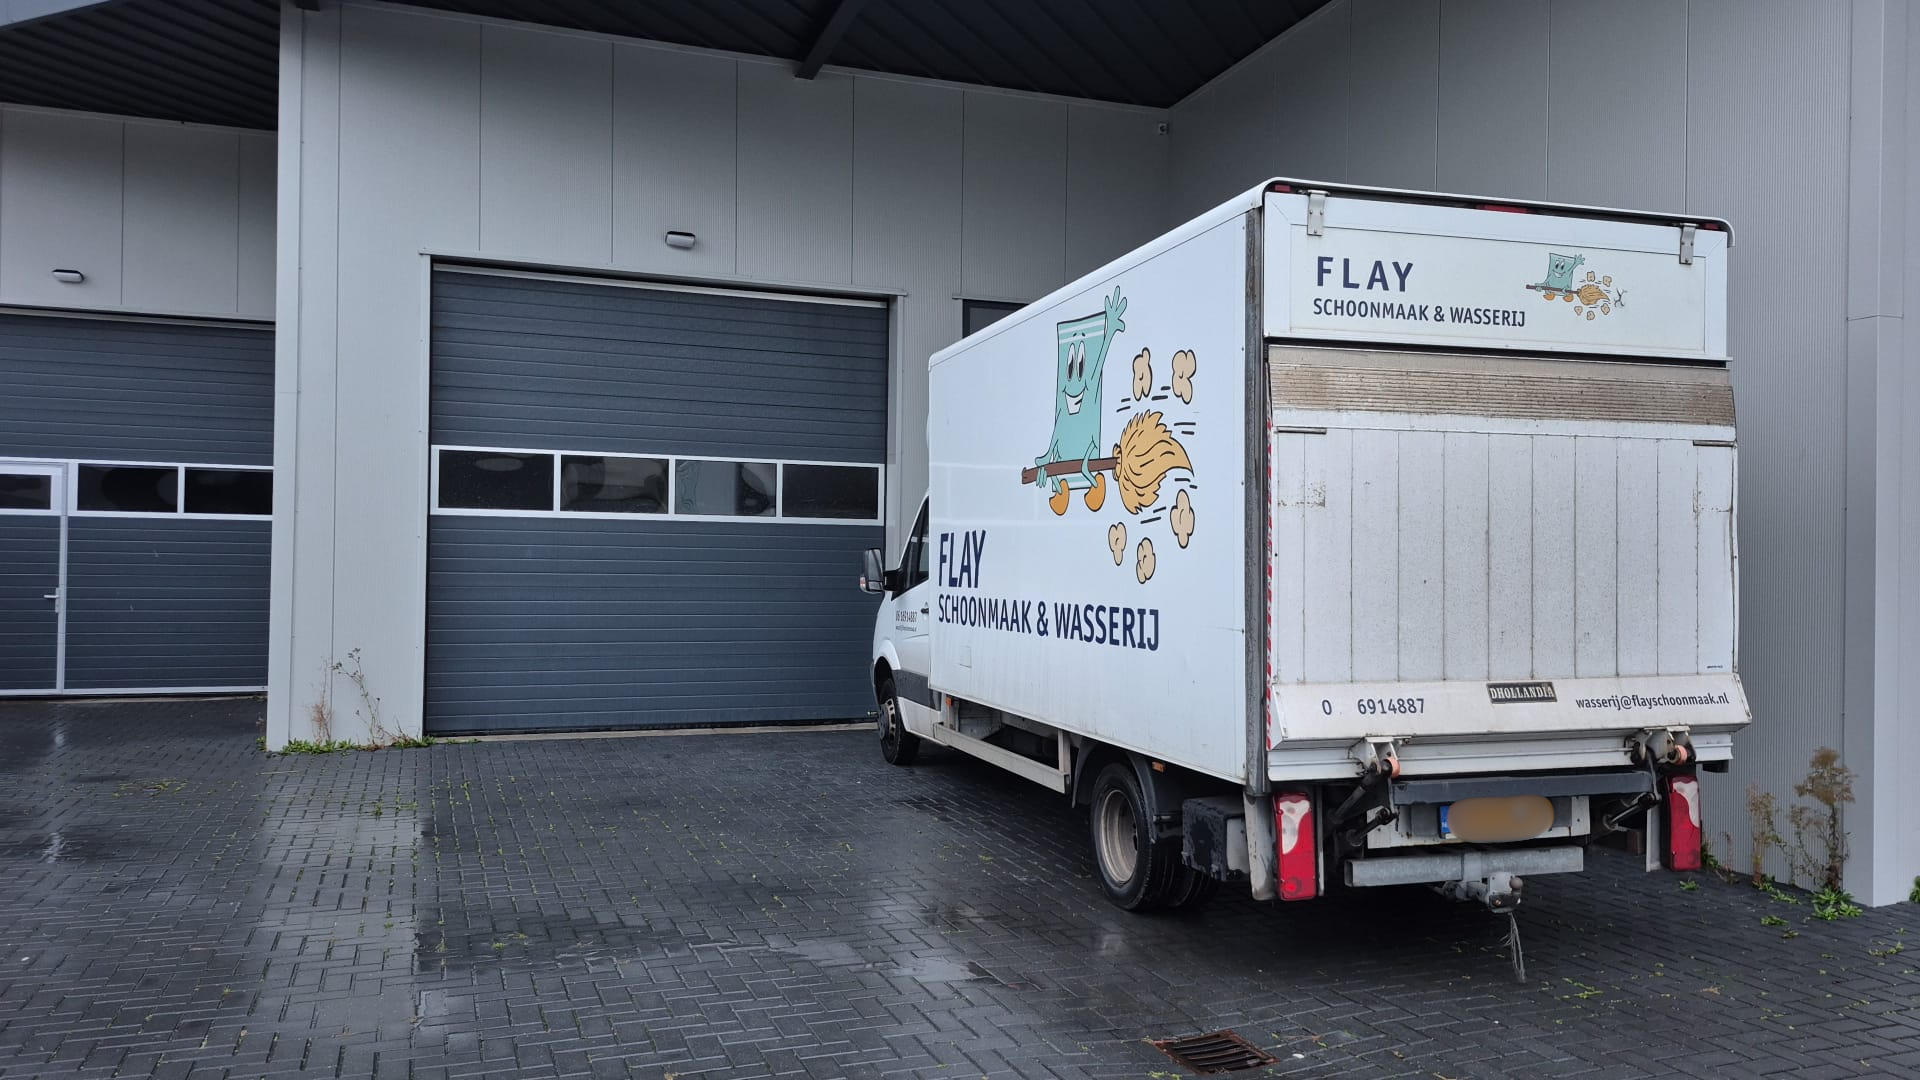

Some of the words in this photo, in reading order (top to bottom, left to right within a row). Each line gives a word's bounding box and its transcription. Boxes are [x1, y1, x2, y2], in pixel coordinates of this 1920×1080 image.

[1317, 256, 1413, 292] FLAY
[1313, 298, 1429, 321] SCHOONMAAK
[1433, 305, 1446, 323] &
[1450, 306, 1526, 328] WASSERIJ
[938, 529, 986, 588] FLAY
[938, 593, 1032, 635] SCHOONMAAK
[1036, 600, 1049, 637] &
[1054, 602, 1160, 652] WASSERIJ
[1321, 699, 1333, 716] 0
[1357, 697, 1425, 715] 6914887
[1489, 686, 1555, 699] DHOLLANDIA
[1576, 692, 1730, 710] wasserij@flayschoonmaak.nl
